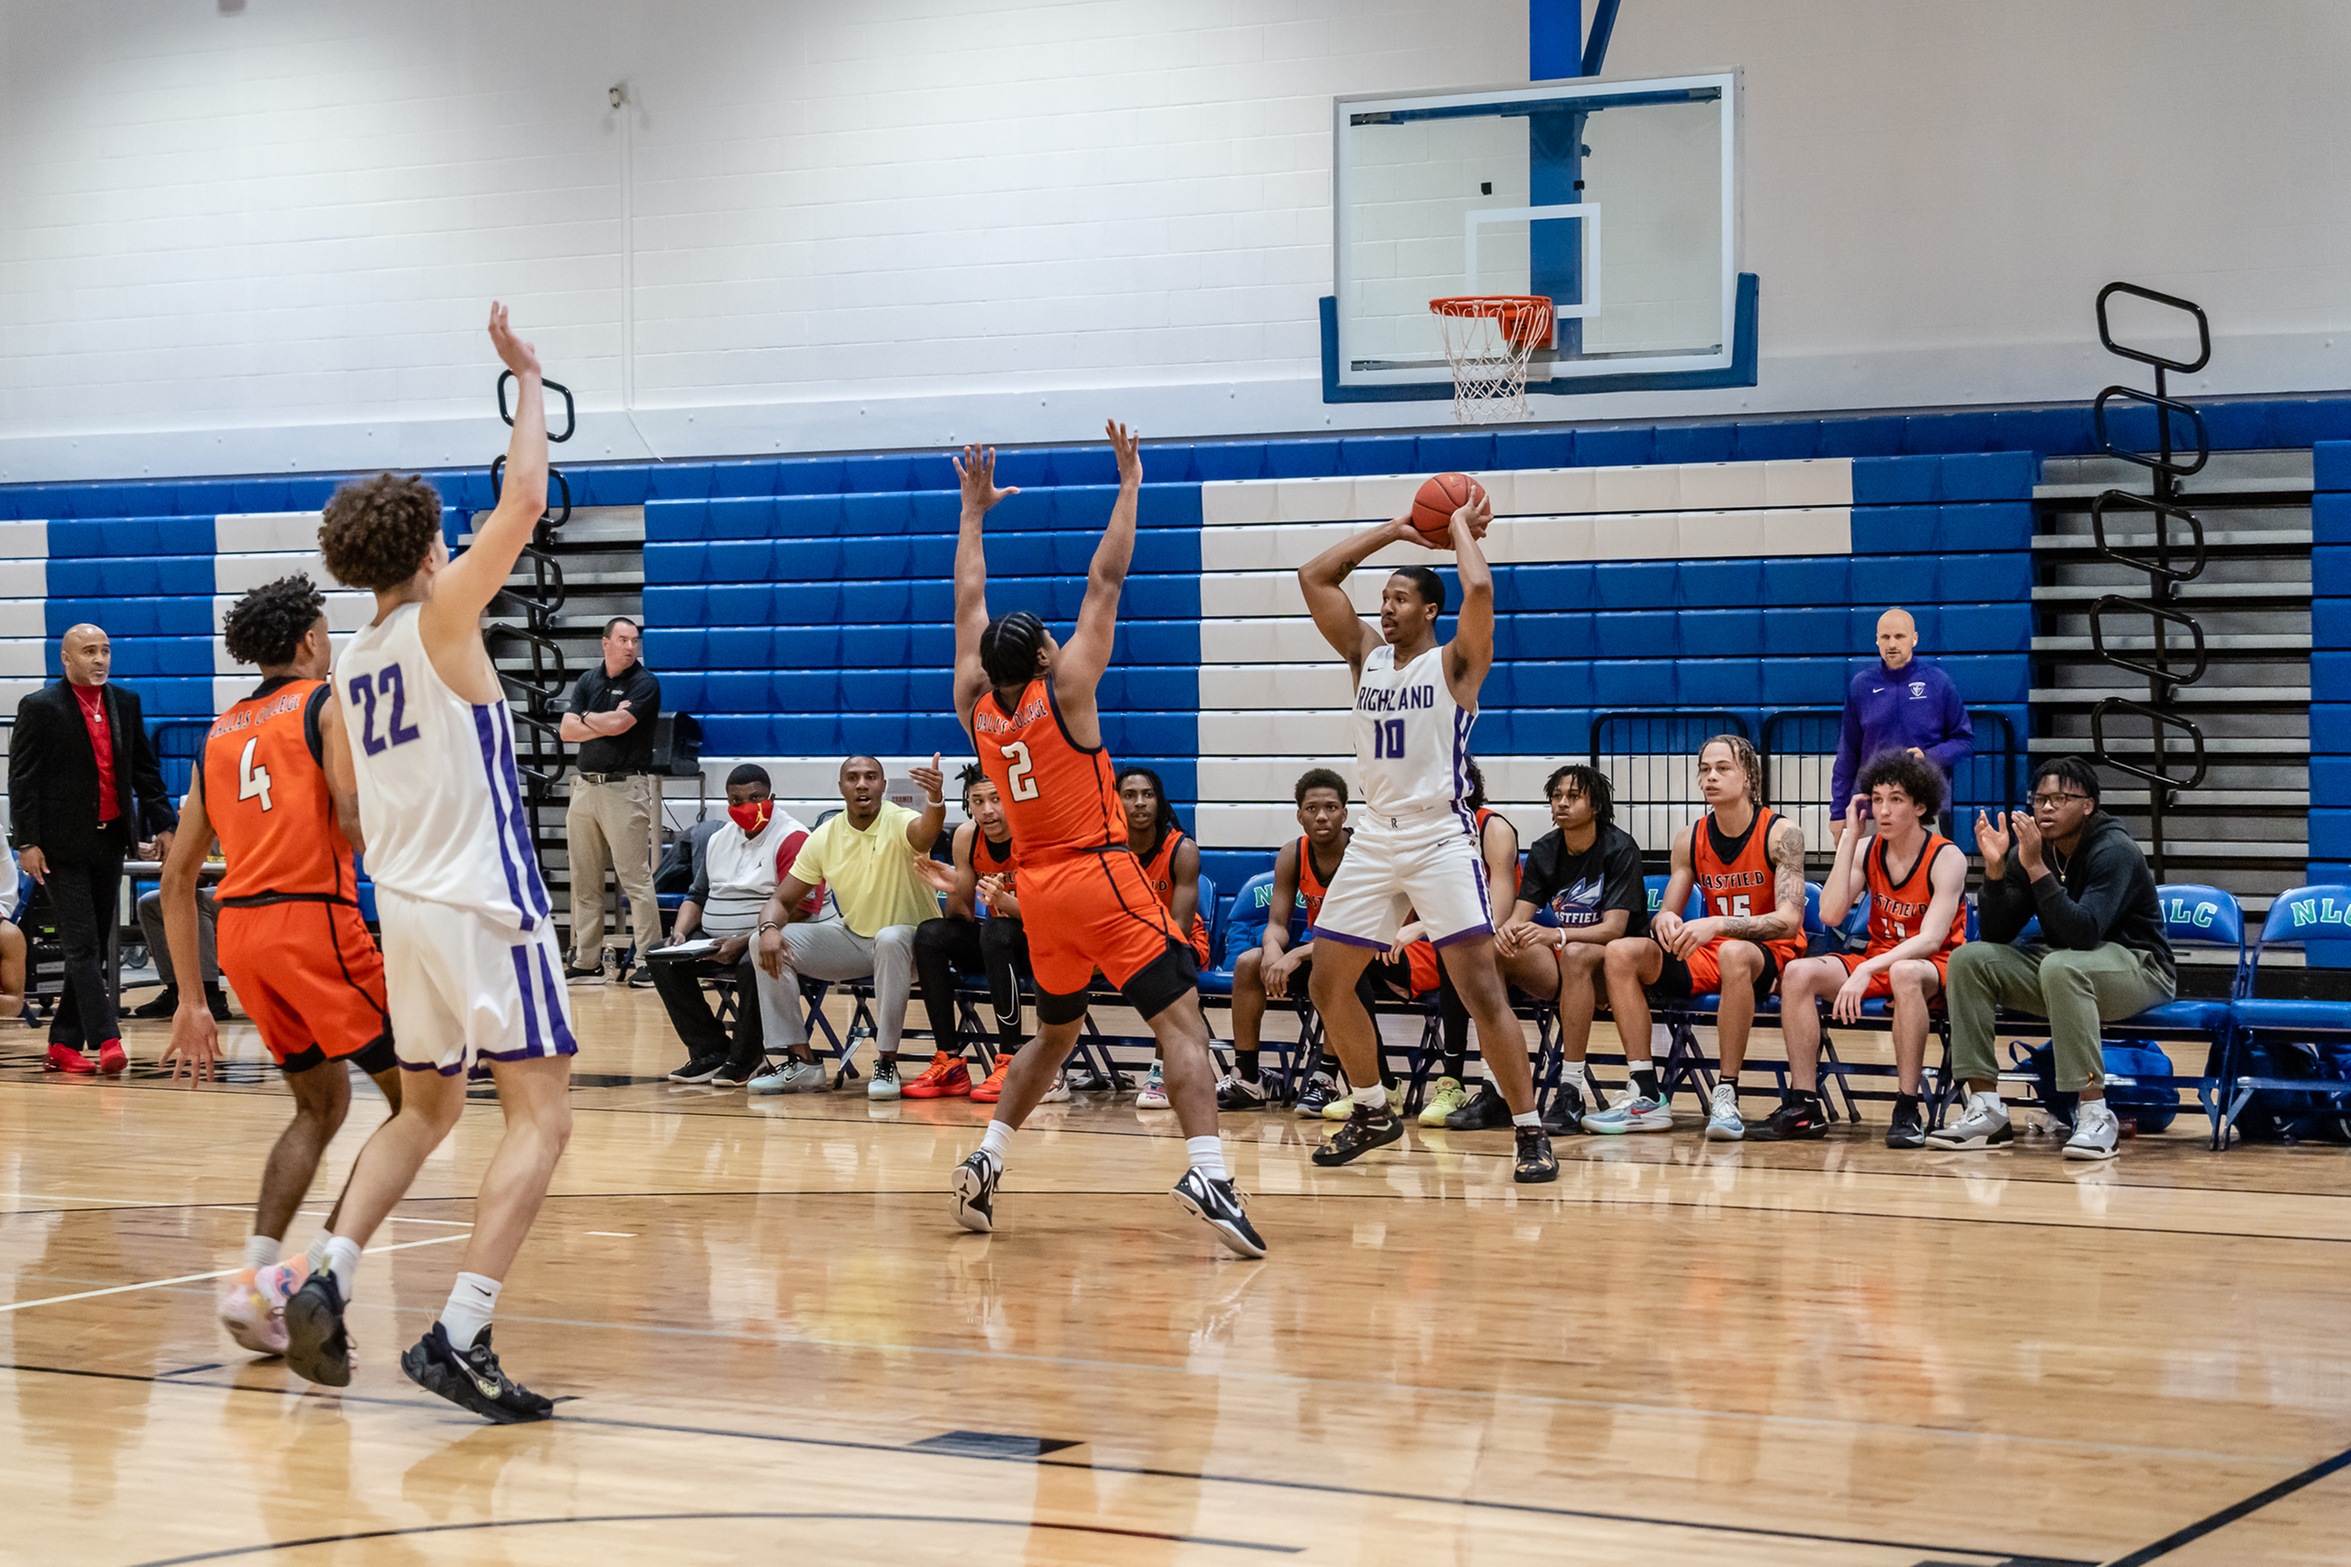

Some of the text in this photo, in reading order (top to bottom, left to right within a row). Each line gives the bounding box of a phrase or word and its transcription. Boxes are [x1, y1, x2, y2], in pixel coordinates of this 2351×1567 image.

[350, 663, 421, 757] 22
[1356, 684, 1435, 712] RICHLAND
[1373, 718, 1406, 760] 10
[237, 735, 273, 813] 4
[1000, 740, 1041, 803] 2
[1715, 894, 1752, 918] 15
[2158, 898, 2219, 928] LC
[2290, 897, 2351, 927] NL
[1880, 917, 1906, 939] 11
